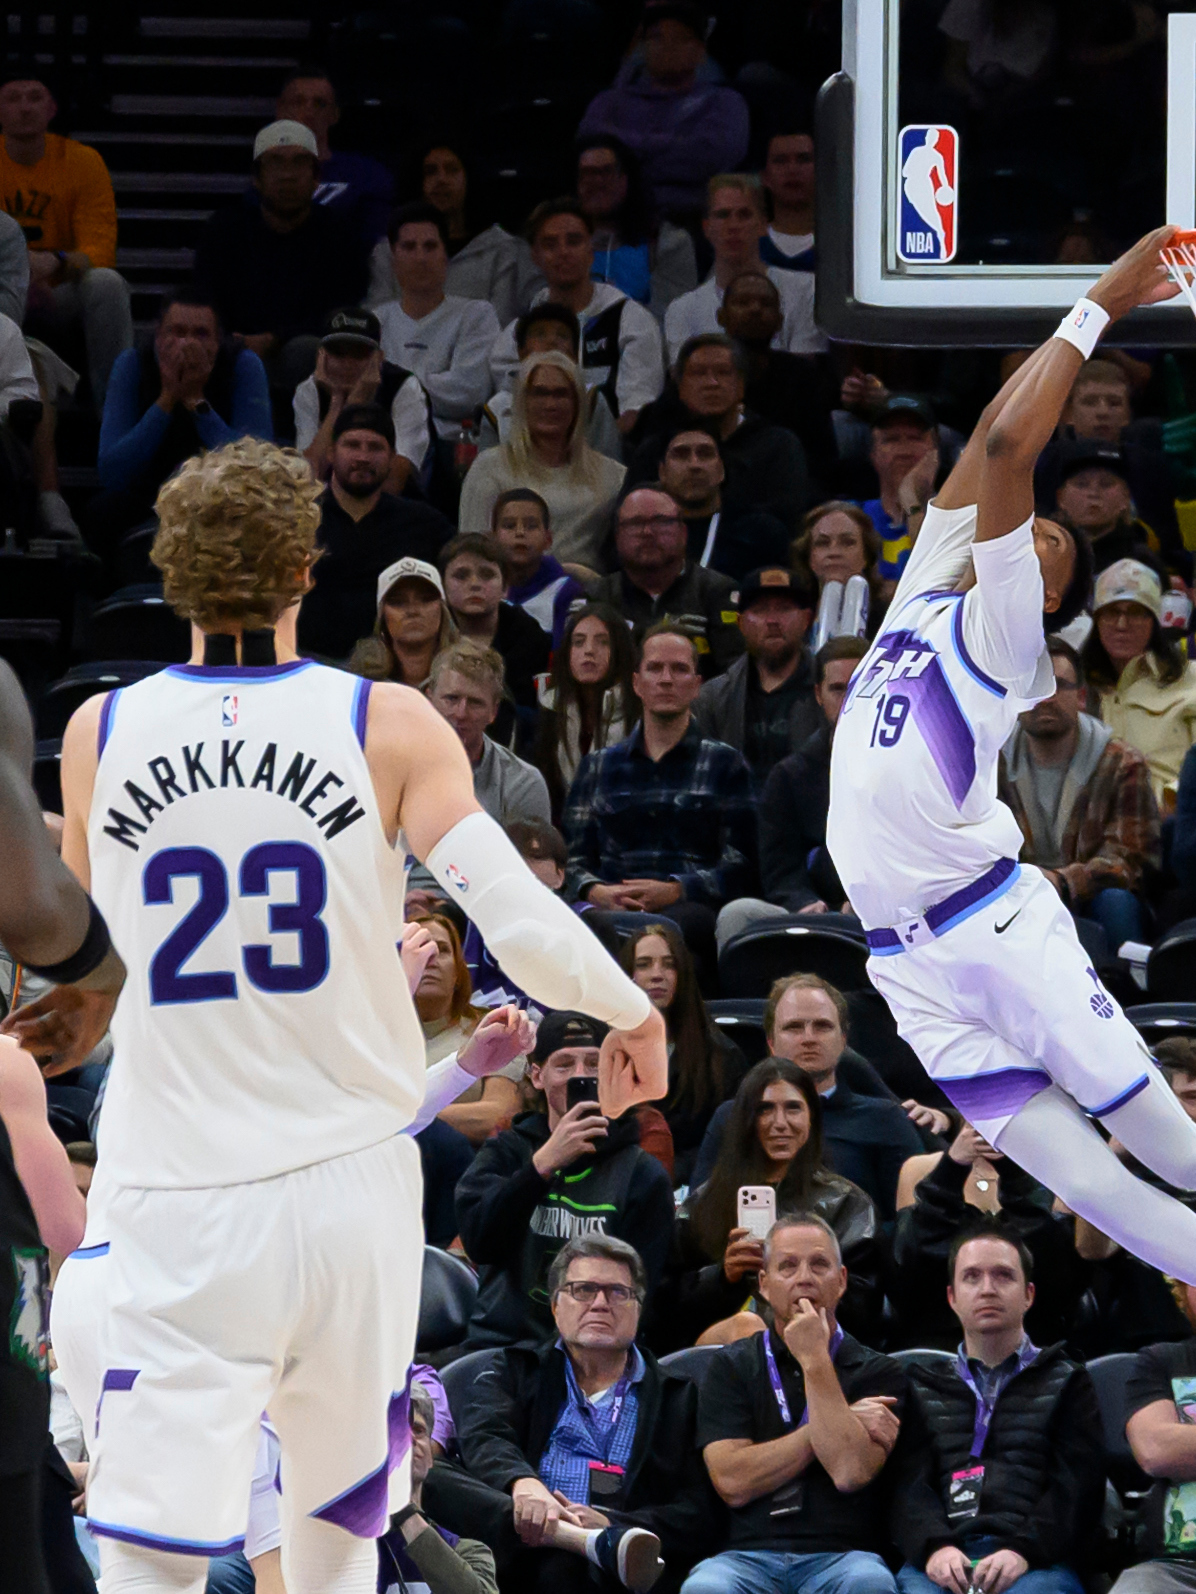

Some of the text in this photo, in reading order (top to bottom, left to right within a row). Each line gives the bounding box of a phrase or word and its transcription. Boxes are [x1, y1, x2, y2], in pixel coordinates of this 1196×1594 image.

[906, 232, 934, 253] NBA
[869, 693, 911, 749] 19
[103, 739, 366, 852] MARKKANEN
[141, 839, 331, 1007] 23
